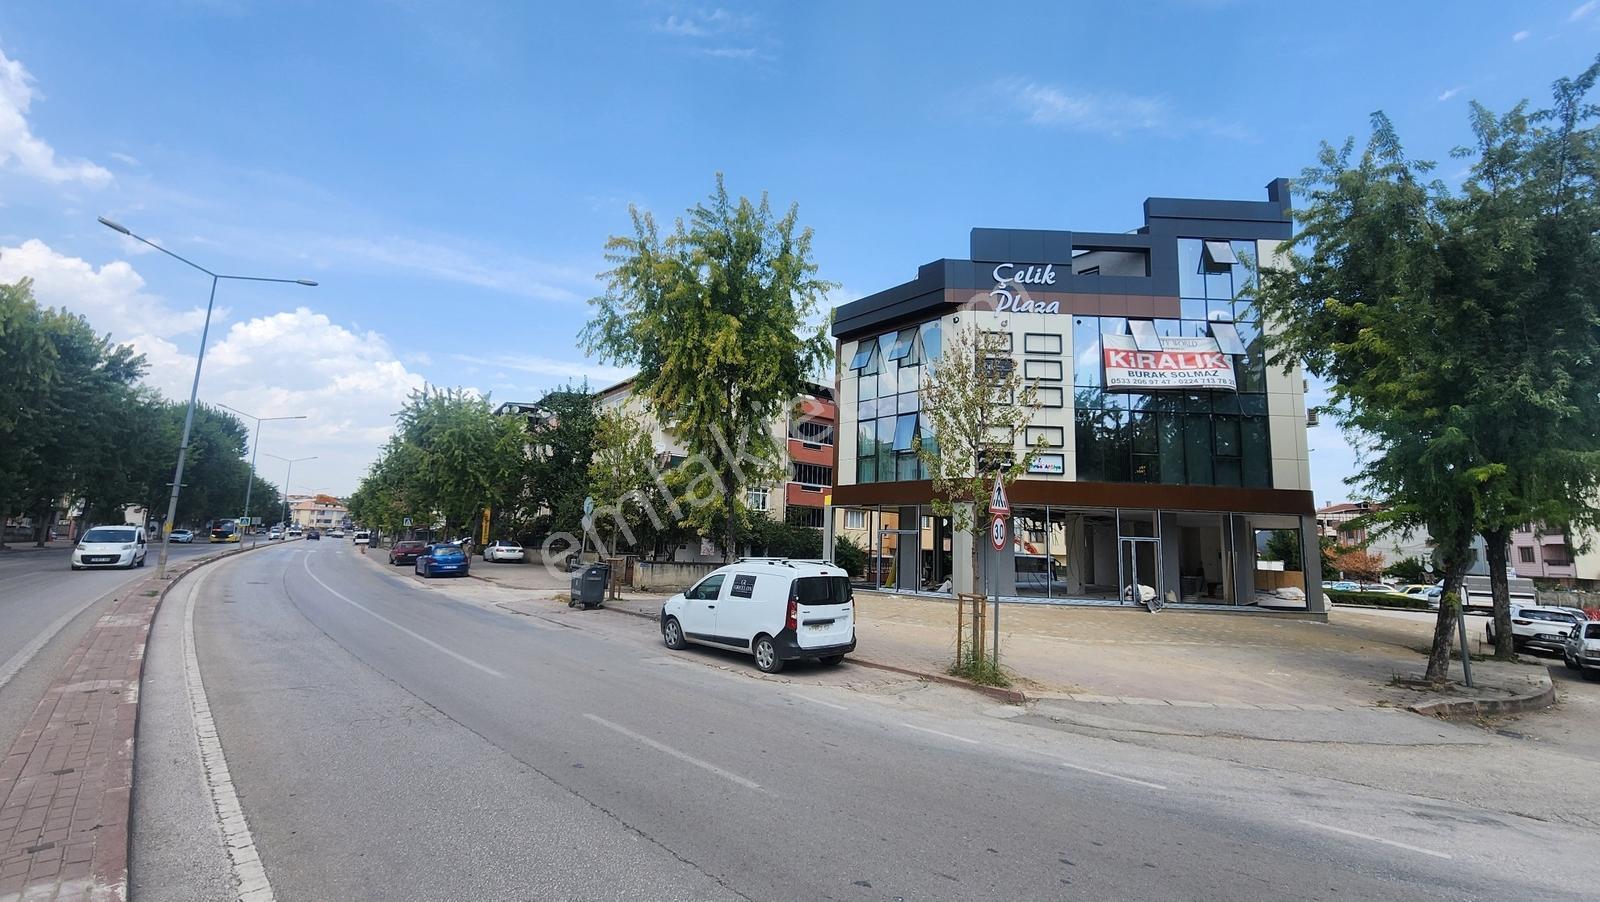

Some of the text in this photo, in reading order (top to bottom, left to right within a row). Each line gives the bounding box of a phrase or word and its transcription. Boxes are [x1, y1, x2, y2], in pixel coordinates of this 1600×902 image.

[993, 263, 1056, 289] Çelik
[990, 290, 1060, 318] Plaza
[1128, 370, 1220, 379] BURAK SOLMAZ
[994, 524, 1004, 540] 30
